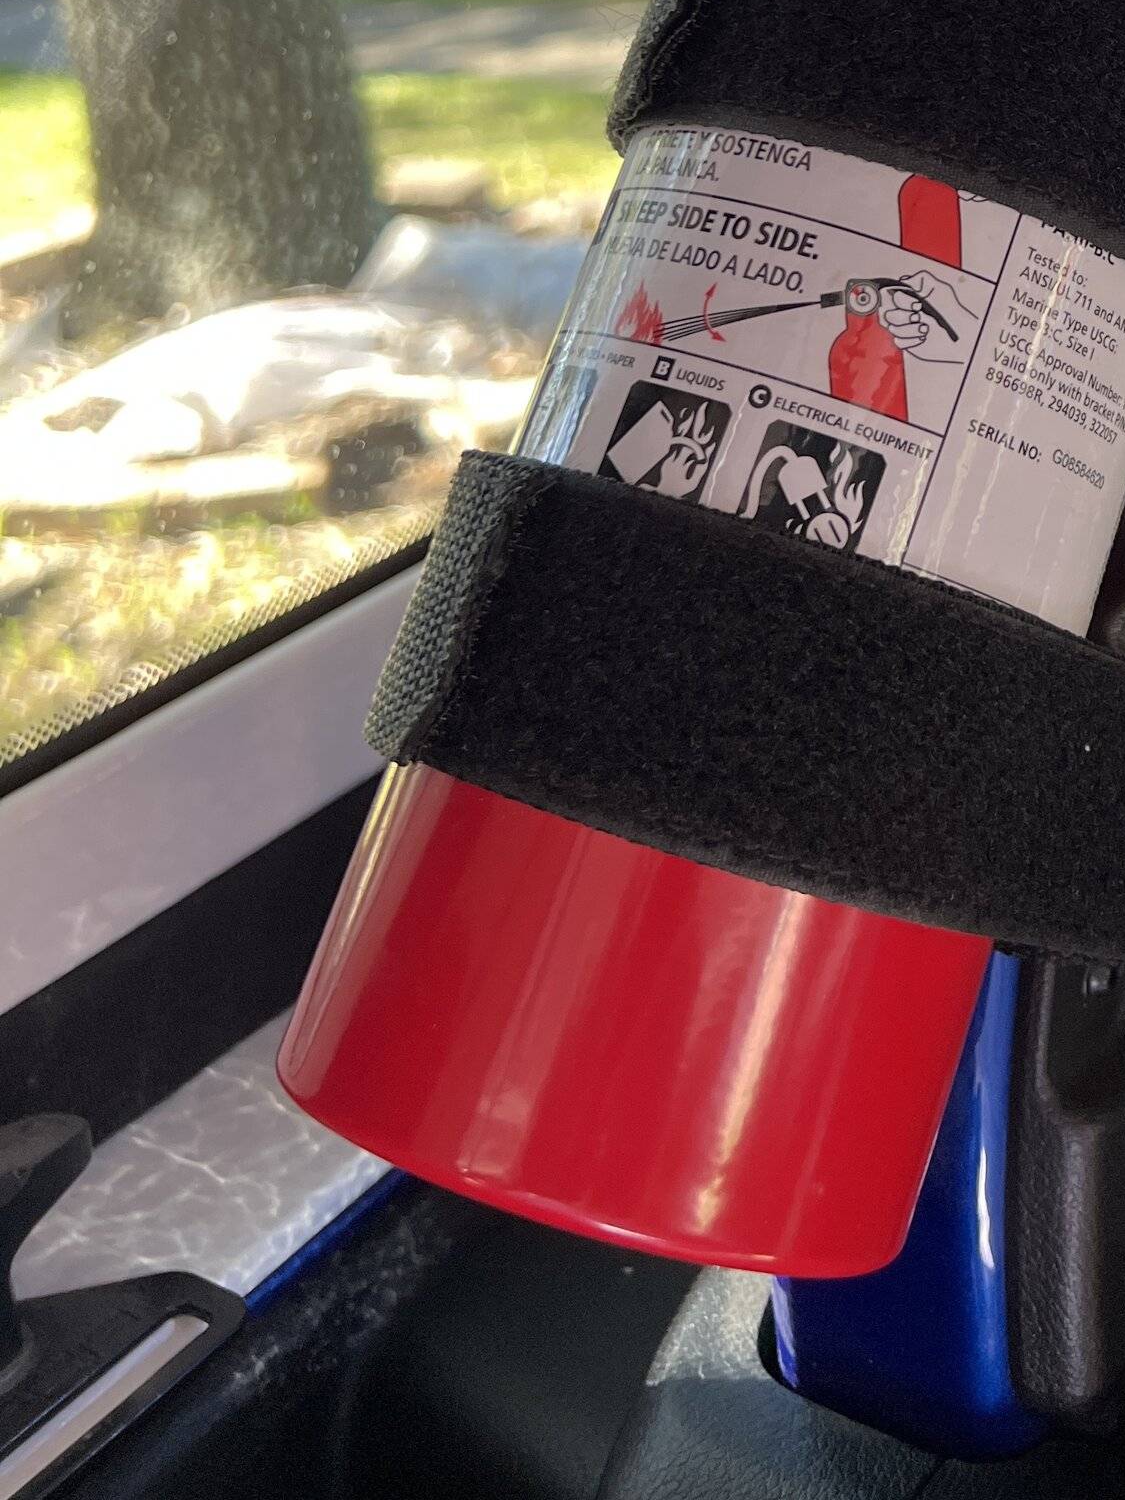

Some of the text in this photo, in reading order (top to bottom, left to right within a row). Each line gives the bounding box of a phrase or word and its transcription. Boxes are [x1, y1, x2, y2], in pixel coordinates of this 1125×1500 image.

[710, 132, 814, 171] SOSTENGA
[667, 203, 719, 234] SIDE
[719, 212, 752, 240] TO
[754, 220, 820, 260] SIDE.
[646, 239, 672, 261] DE
[670, 242, 722, 271] LADO
[721, 254, 738, 276] A
[742, 258, 805, 294] LADO.
[1026, 245, 1089, 288] Tested to:
[1011, 287, 1059, 322] Marine
[1061, 310, 1089, 339] Type
[1073, 290, 1094, 311] 711
[1093, 303, 1115, 324] and
[1006, 305, 1039, 332] Type
[1065, 334, 1089, 358] Size
[606, 351, 636, 369] PAPER
[675, 367, 727, 392] LIQUIDS
[1035, 348, 1088, 383] Approval
[984, 366, 1045, 408] 896698R,
[1047, 395, 1088, 431] 294039,
[1088, 418, 1119, 445] 322057
[992, 347, 1027, 374] Valid
[1029, 366, 1057, 391] only
[1057, 378, 1083, 401] with
[1083, 389, 1116, 423] bracket
[772, 395, 850, 432] ELECTRICAL
[854, 422, 934, 460] EQUIPMENT
[967, 418, 1015, 451] SERIAL
[1017, 440, 1043, 463] NO:
